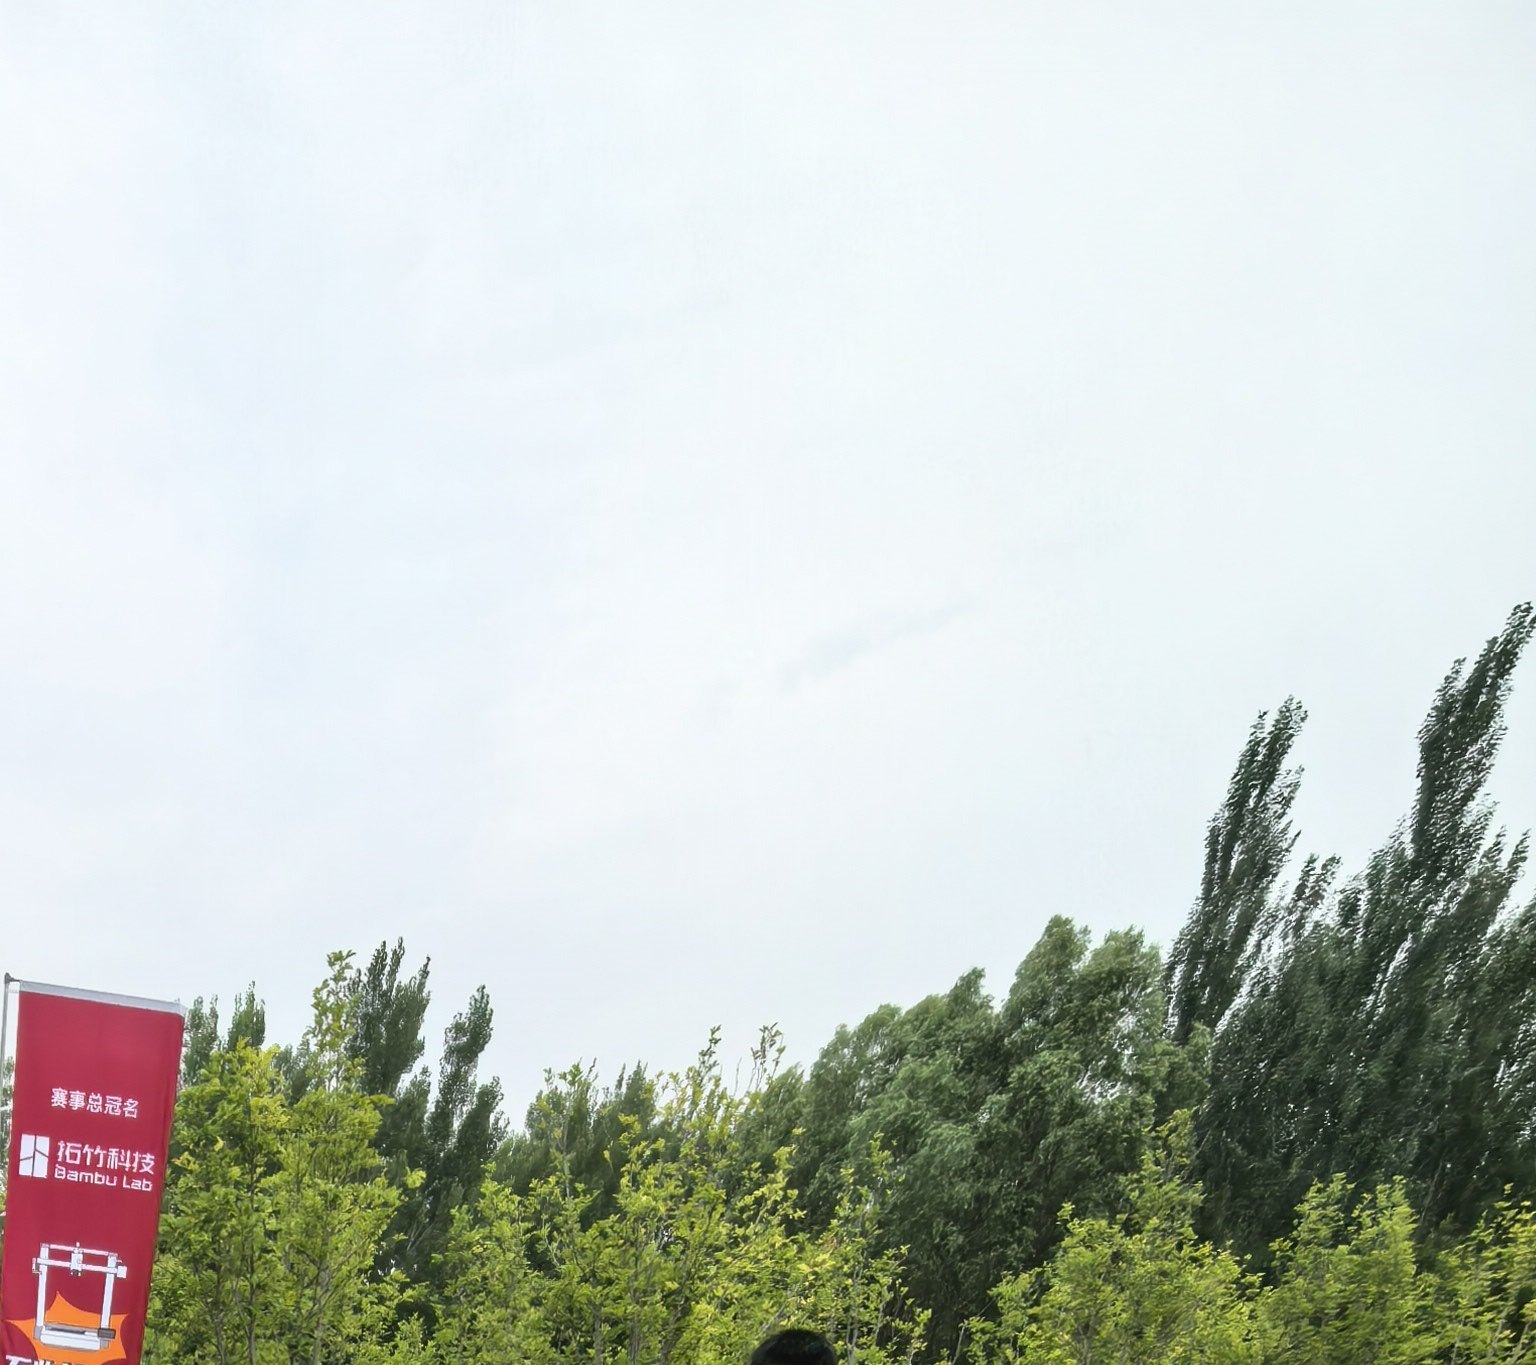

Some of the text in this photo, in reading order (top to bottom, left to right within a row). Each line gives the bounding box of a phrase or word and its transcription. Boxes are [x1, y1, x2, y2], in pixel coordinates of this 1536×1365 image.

[51, 1087, 139, 1118] 赛事总冠名
[57, 1140, 155, 1175] 拓竹科技
[54, 1164, 153, 1192] Bambu Lab
